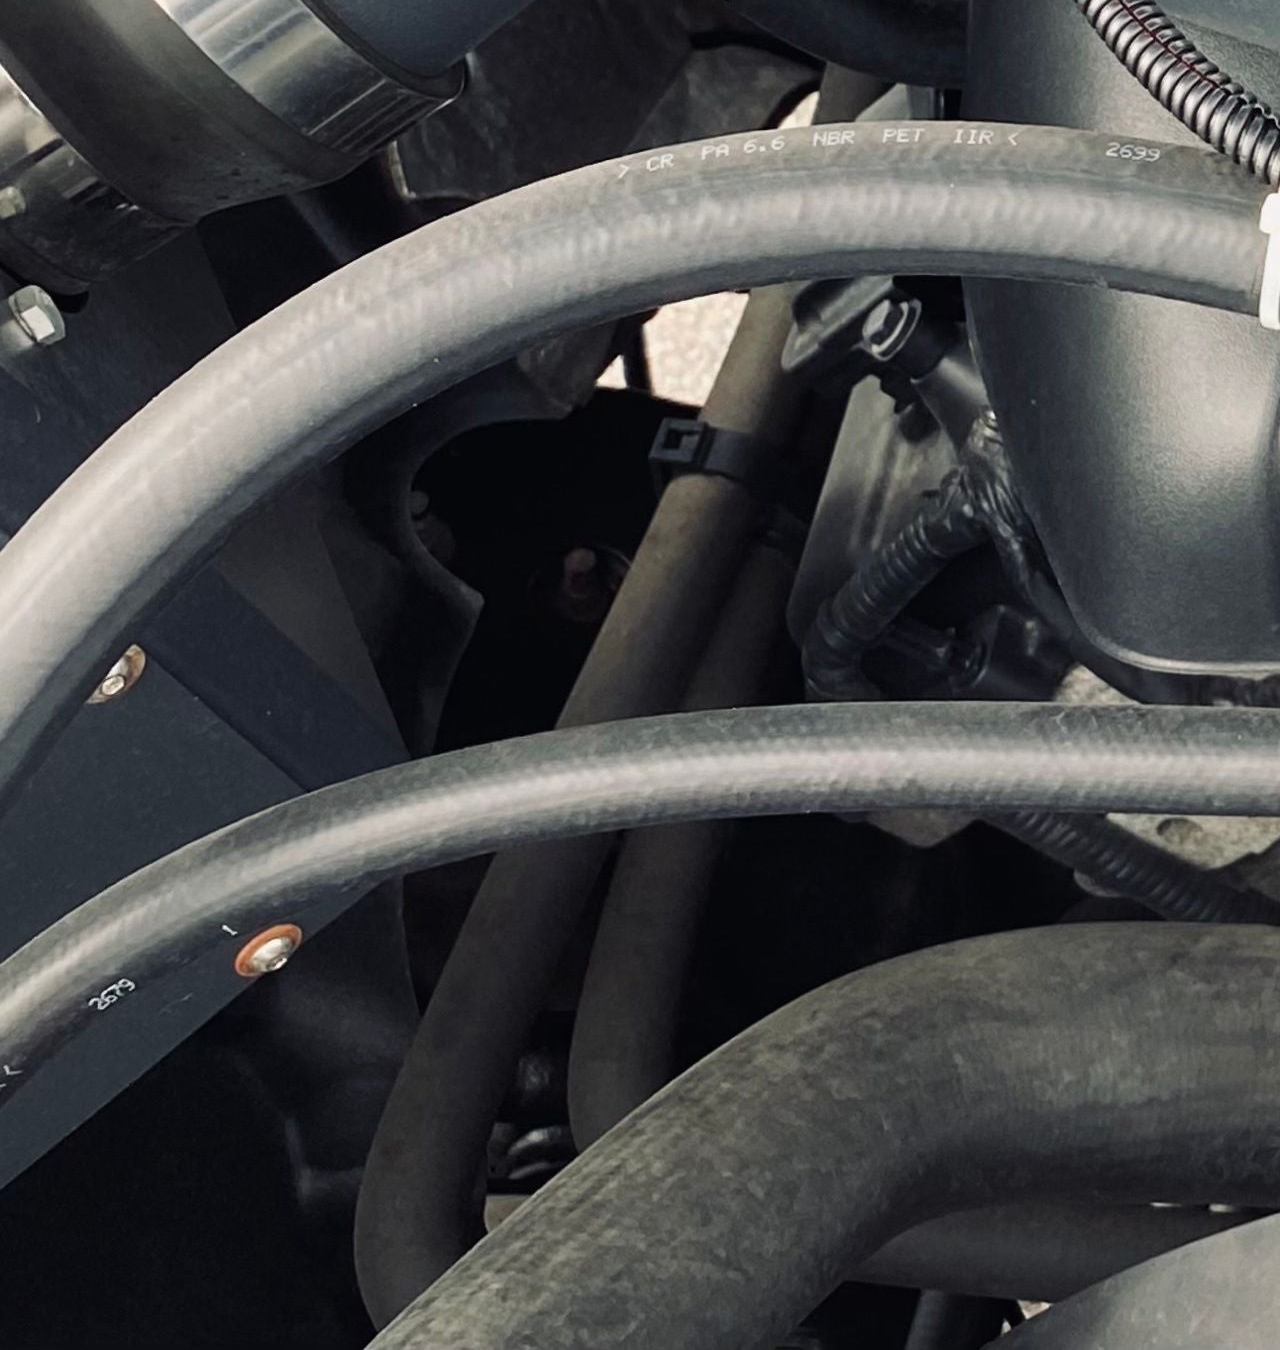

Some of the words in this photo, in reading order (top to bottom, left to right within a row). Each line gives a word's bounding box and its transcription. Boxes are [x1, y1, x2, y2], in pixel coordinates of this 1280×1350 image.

[646, 153, 675, 173] CR
[700, 143, 730, 161] PA
[743, 134, 787, 154] 6.6
[813, 128, 856, 148] NBR
[881, 127, 926, 145] PET
